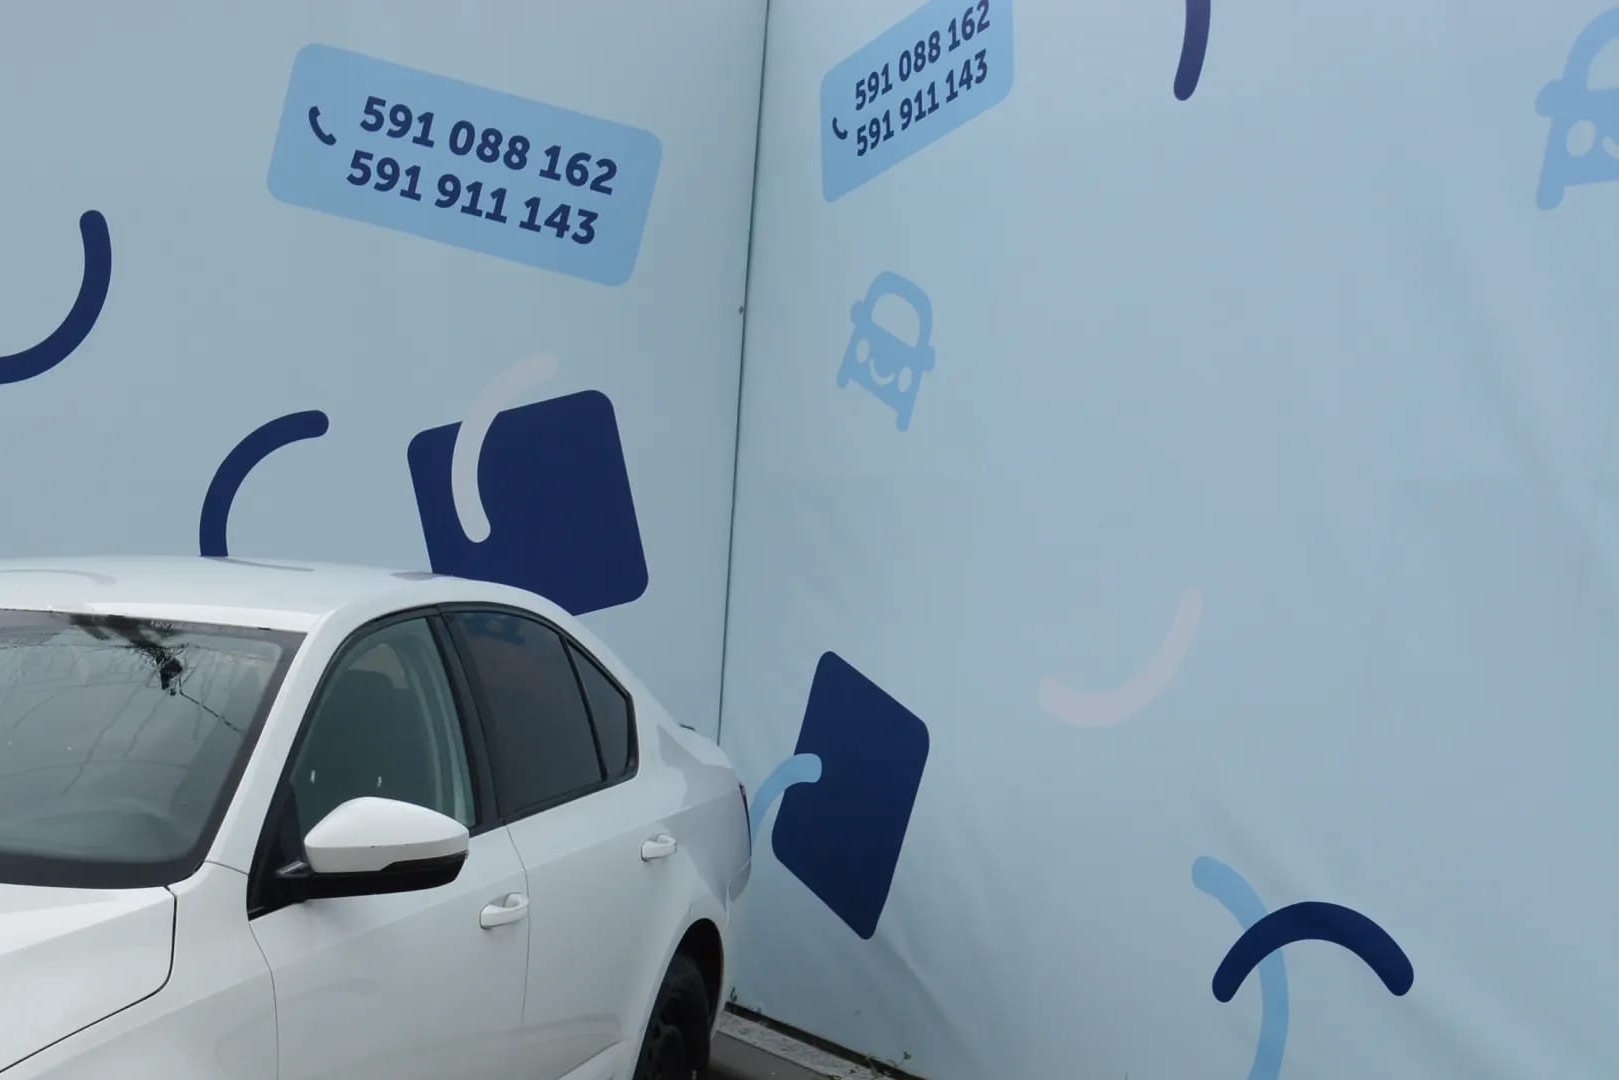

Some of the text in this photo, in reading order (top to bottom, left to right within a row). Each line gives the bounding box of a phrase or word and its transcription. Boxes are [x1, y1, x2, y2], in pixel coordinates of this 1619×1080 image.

[855, 0, 990, 111] 591 088 162
[856, 48, 988, 157] 591 911 143
[345, 149, 600, 245] 591 911 143
[359, 95, 618, 196] 591 088 162
